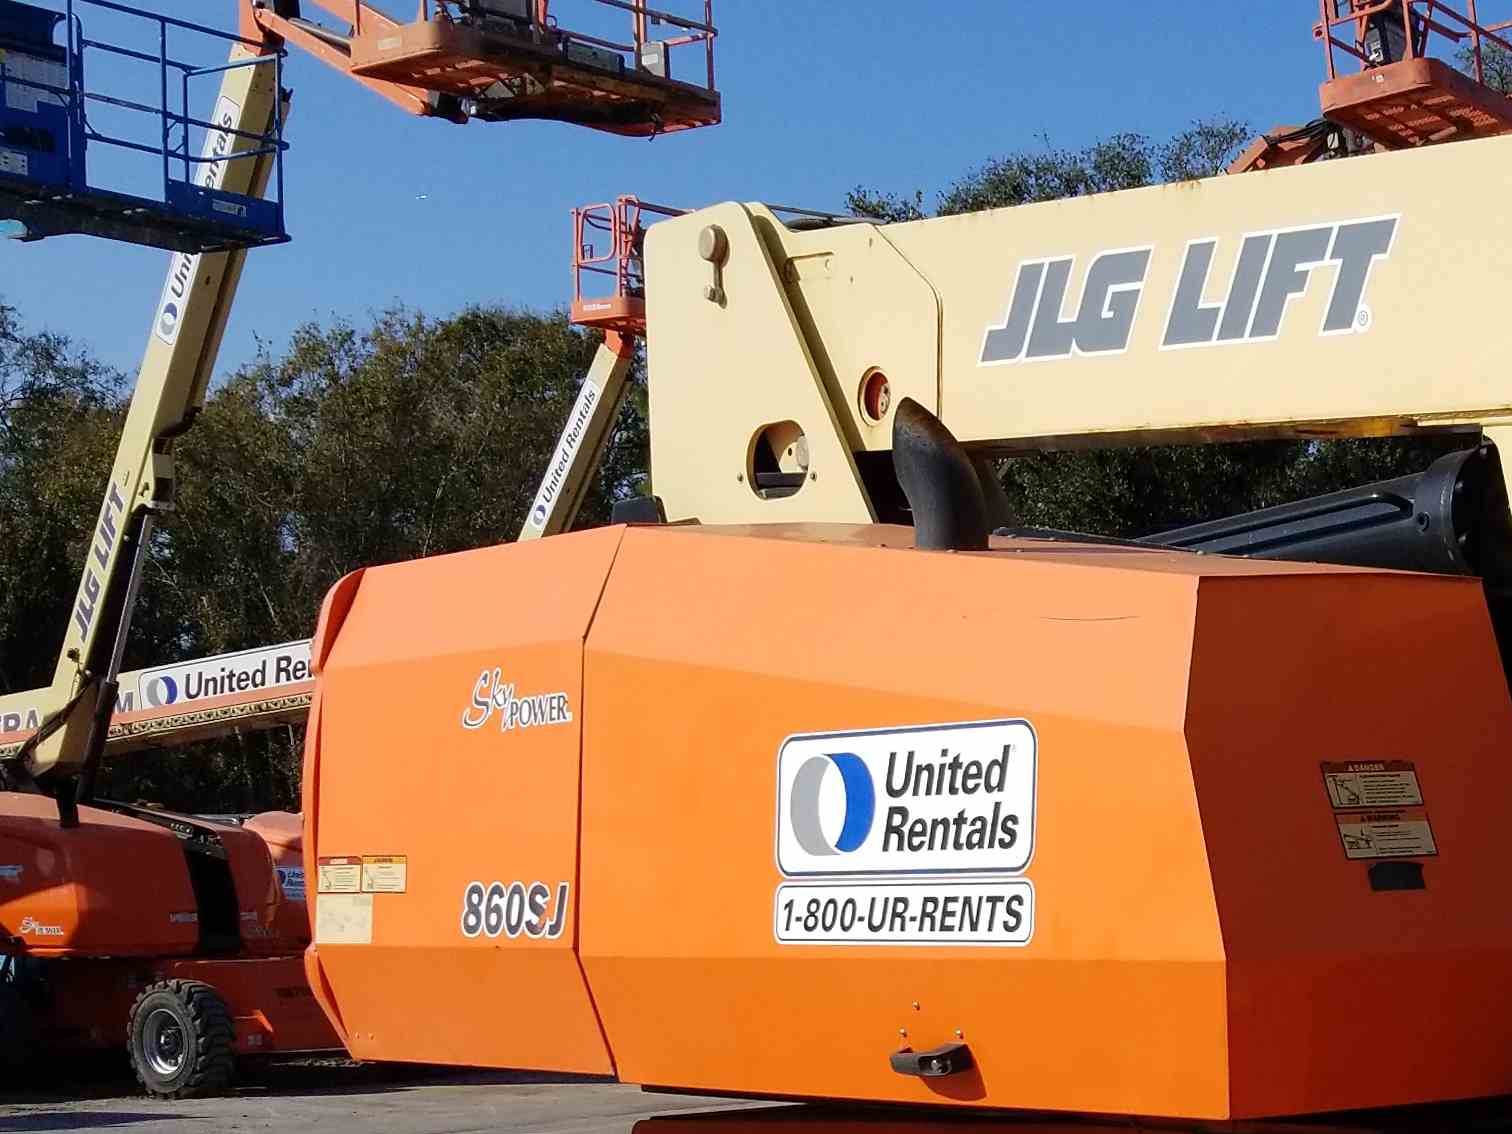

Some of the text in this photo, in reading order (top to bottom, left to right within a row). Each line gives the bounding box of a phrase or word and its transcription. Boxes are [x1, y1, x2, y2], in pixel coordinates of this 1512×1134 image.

[977, 216, 1399, 365] JLG LIFT
[542, 389, 596, 504] United Rentals
[74, 479, 124, 644] JLG LIFT
[184, 659, 267, 700] United
[509, 691, 570, 728] POWER
[885, 743, 1012, 799] United
[881, 801, 1020, 853] Rentals
[462, 881, 569, 938] 860SJ
[783, 894, 1025, 933] 1-800-UR-RENTS
